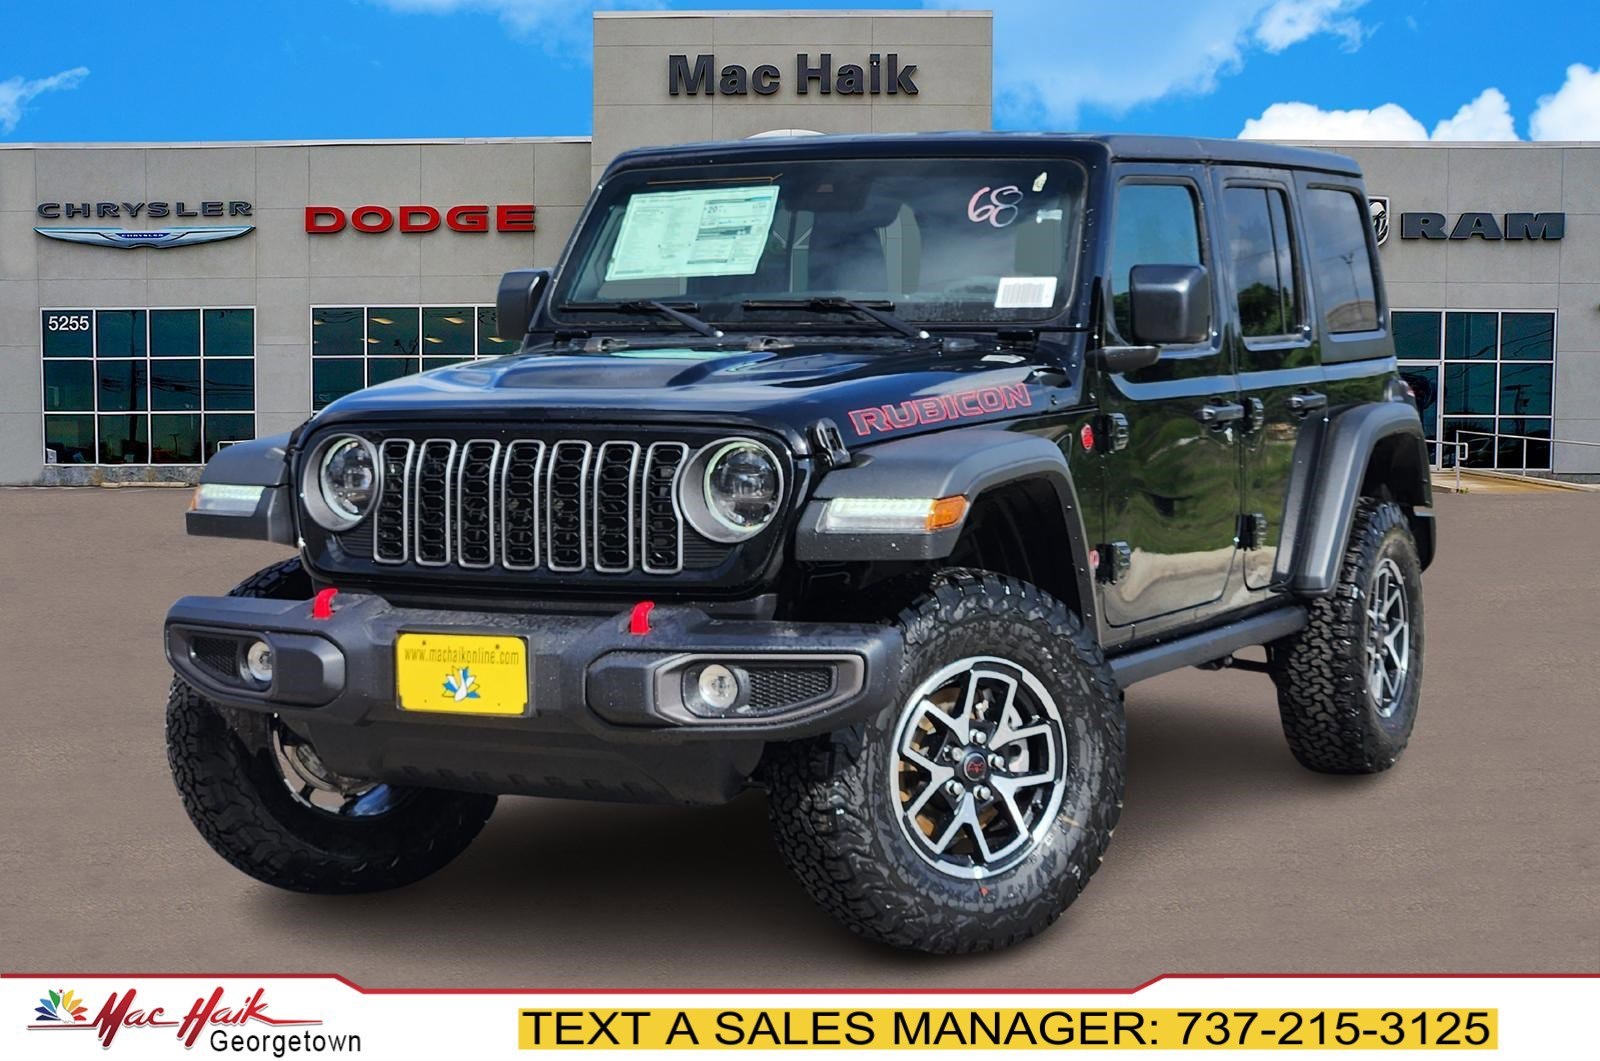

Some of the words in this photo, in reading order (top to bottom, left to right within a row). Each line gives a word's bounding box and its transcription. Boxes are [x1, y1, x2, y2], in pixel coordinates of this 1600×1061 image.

[668, 53, 781, 96] Mac
[796, 53, 919, 96] Haik
[37, 201, 253, 218] CHRYSLER
[305, 204, 537, 234] DODGE
[967, 185, 1024, 228] 68
[1401, 211, 1566, 241] RAM
[48, 315, 90, 331] 5255
[848, 383, 1032, 436] RUBICON
[404, 647, 519, 664] www.machaikonline.com
